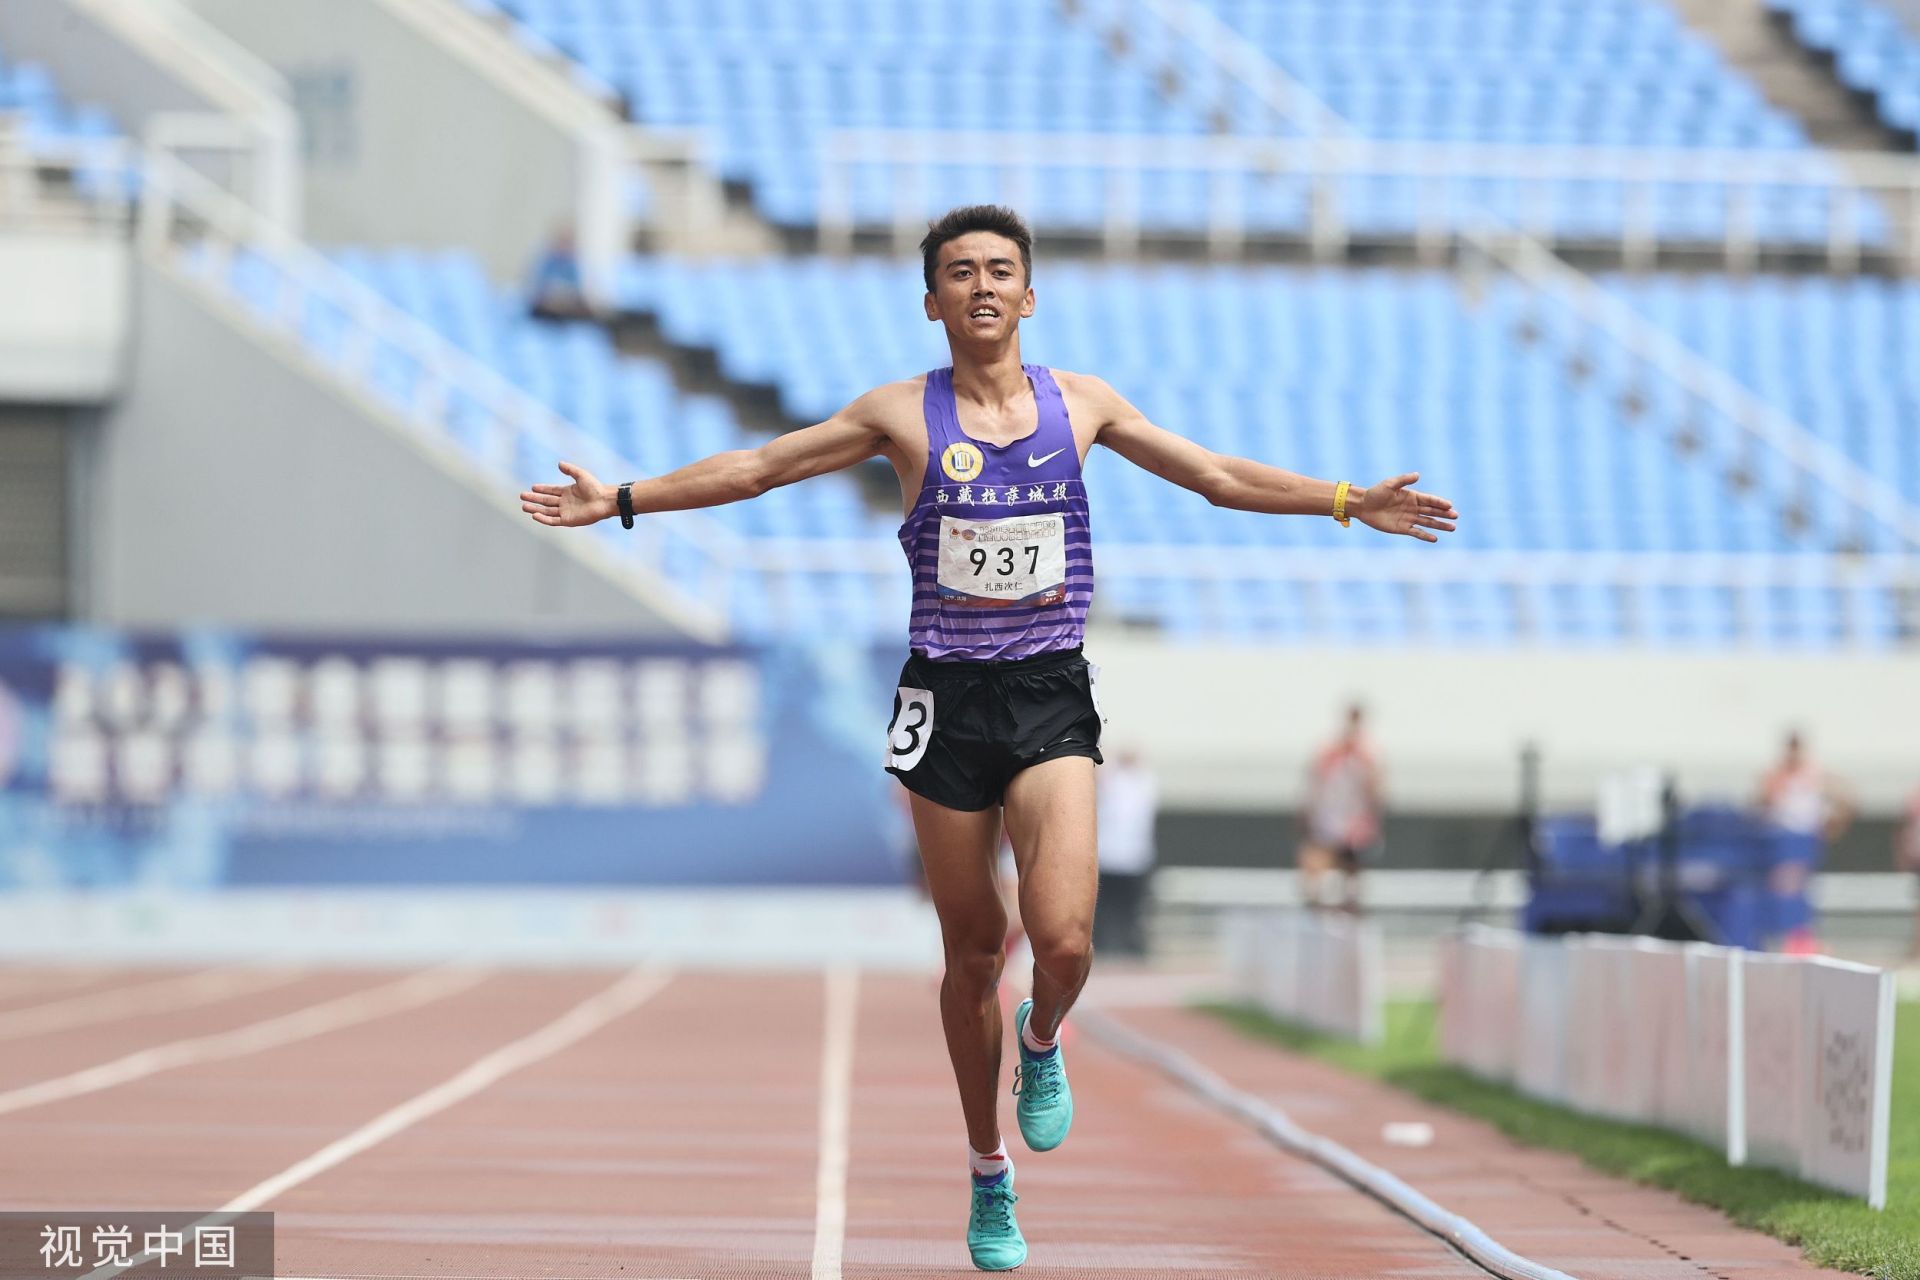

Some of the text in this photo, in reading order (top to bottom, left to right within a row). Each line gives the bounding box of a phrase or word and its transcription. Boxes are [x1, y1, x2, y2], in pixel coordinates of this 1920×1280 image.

[936, 483, 1068, 506] 西藏拉萨城投
[969, 545, 1040, 576] 937
[984, 581, 1024, 592] 扎西次仁
[892, 701, 927, 756] 3
